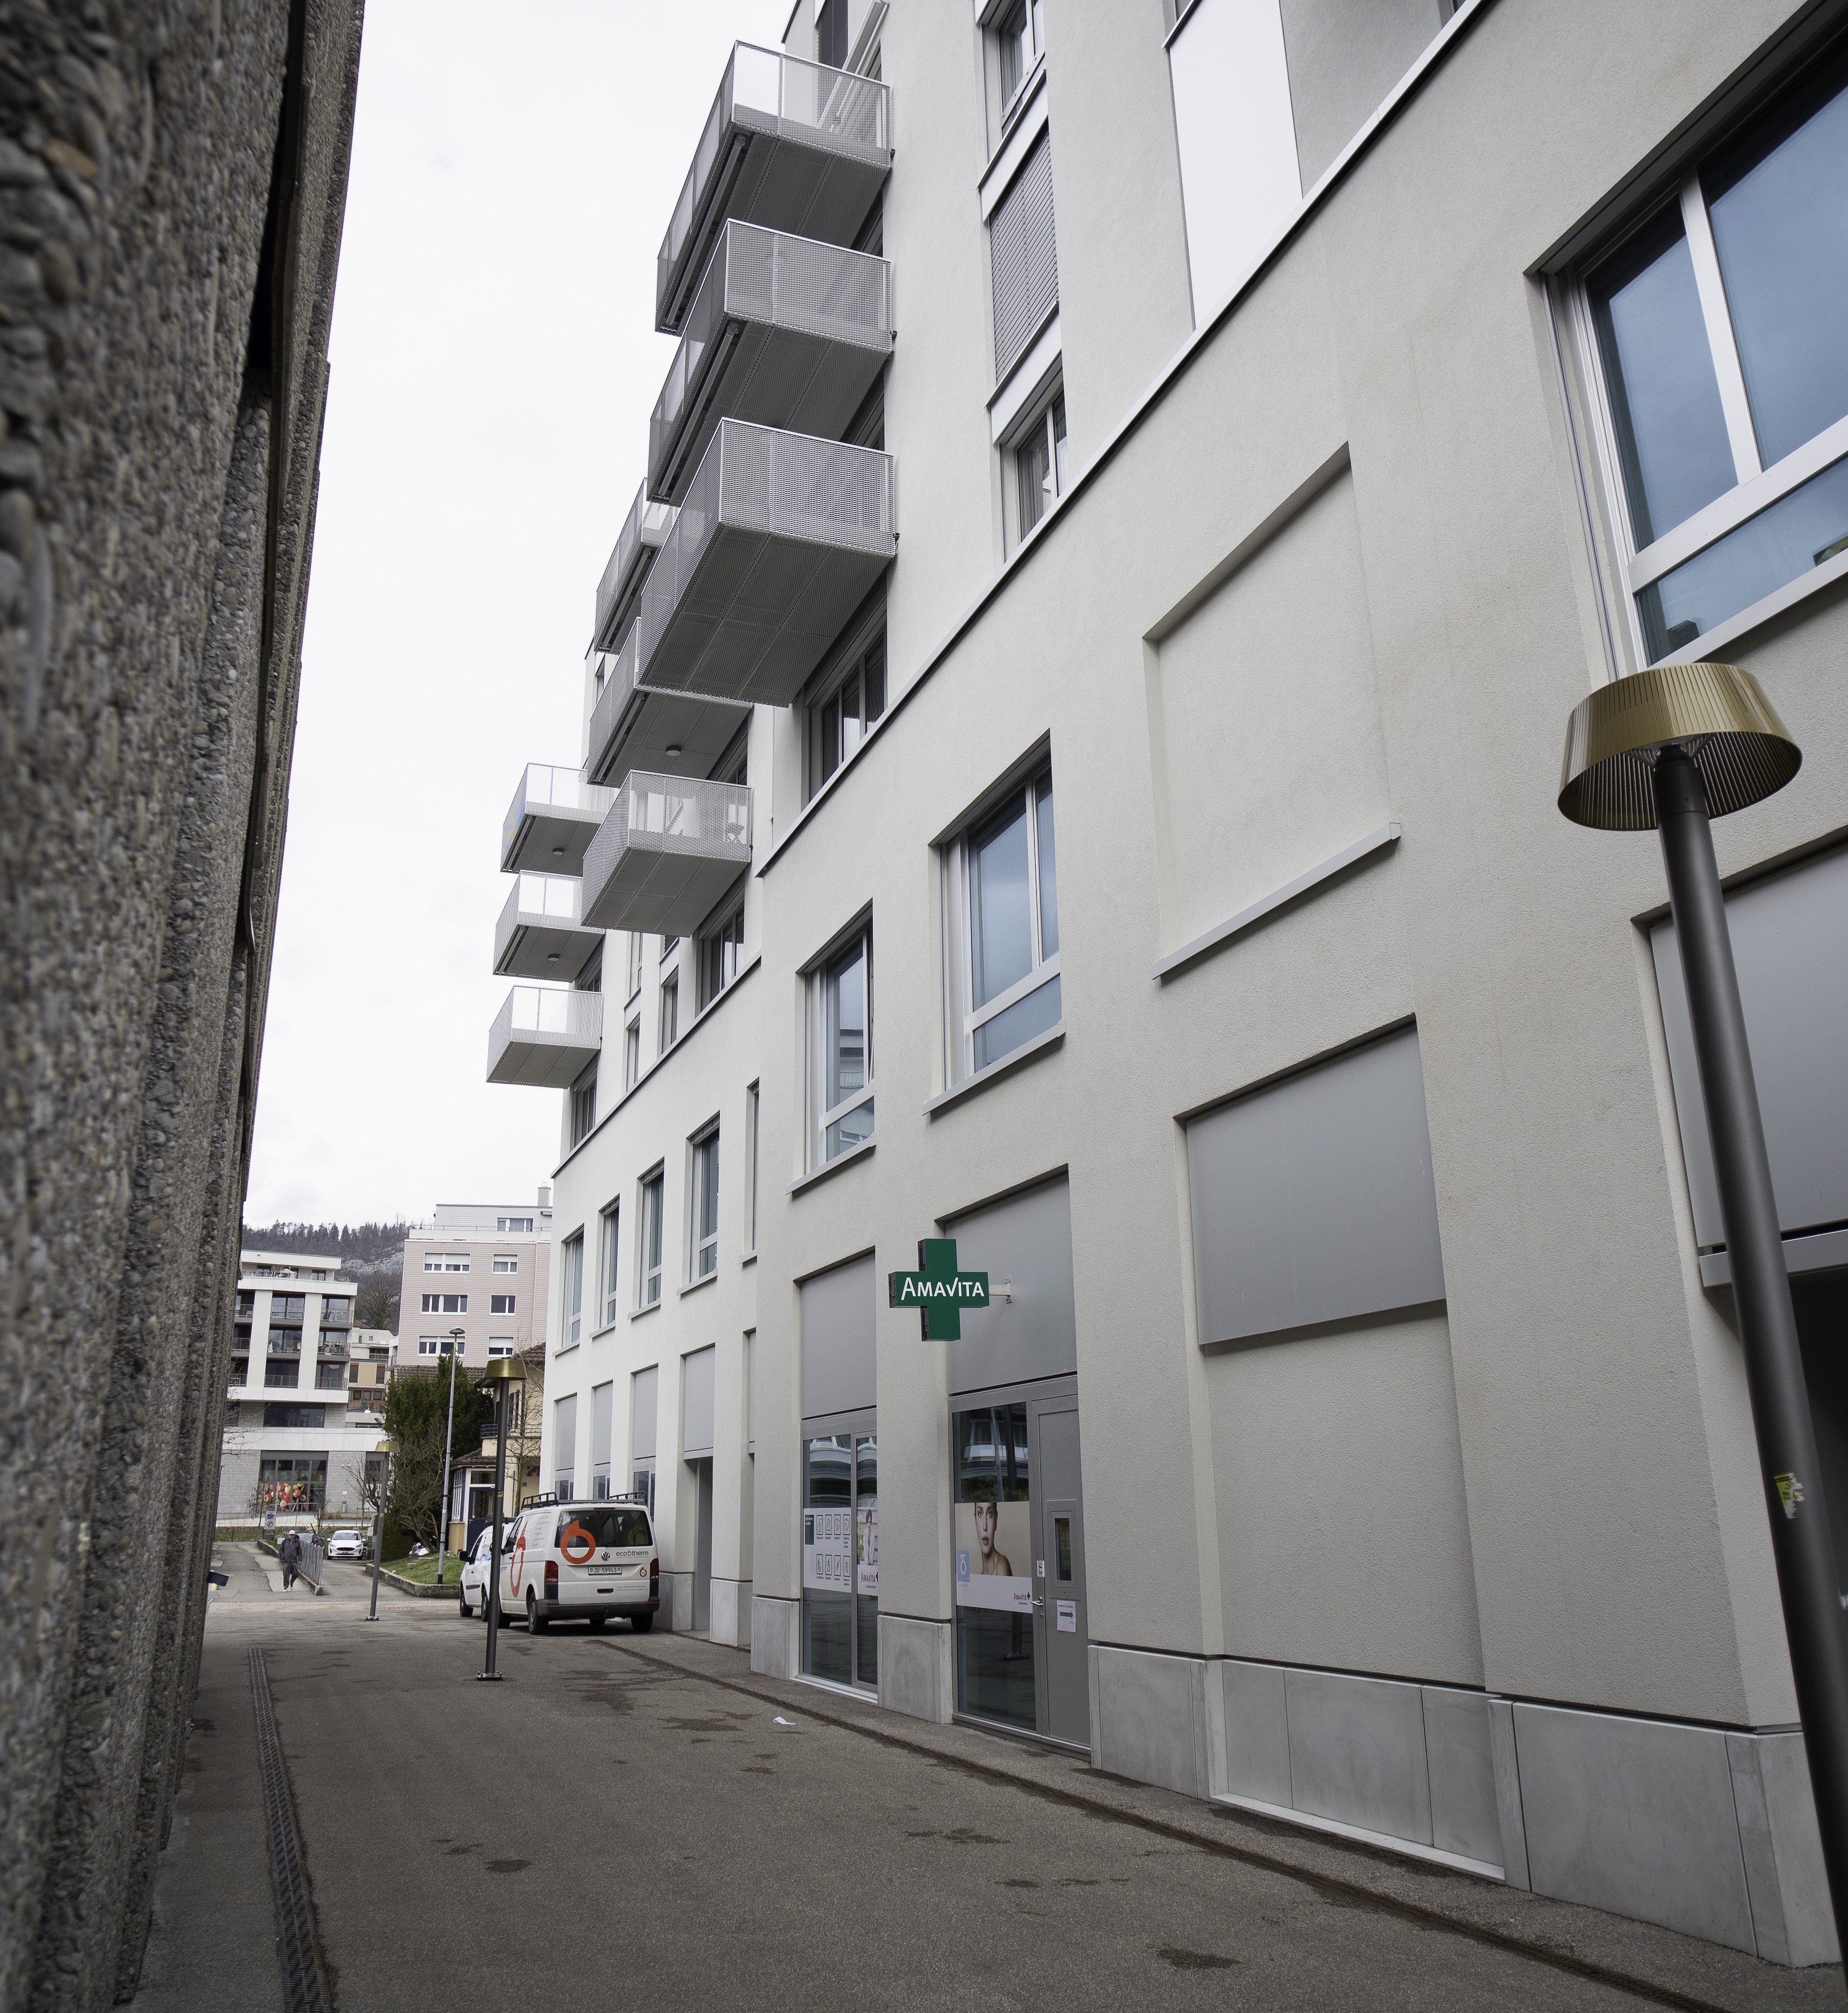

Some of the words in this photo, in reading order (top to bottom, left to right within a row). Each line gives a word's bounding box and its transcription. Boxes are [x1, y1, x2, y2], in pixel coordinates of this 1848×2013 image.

[901, 1277, 985, 1300] AMAVITA
[860, 1572, 876, 1583] AMAVITA
[1013, 1592, 1027, 1601] AMAVITA
